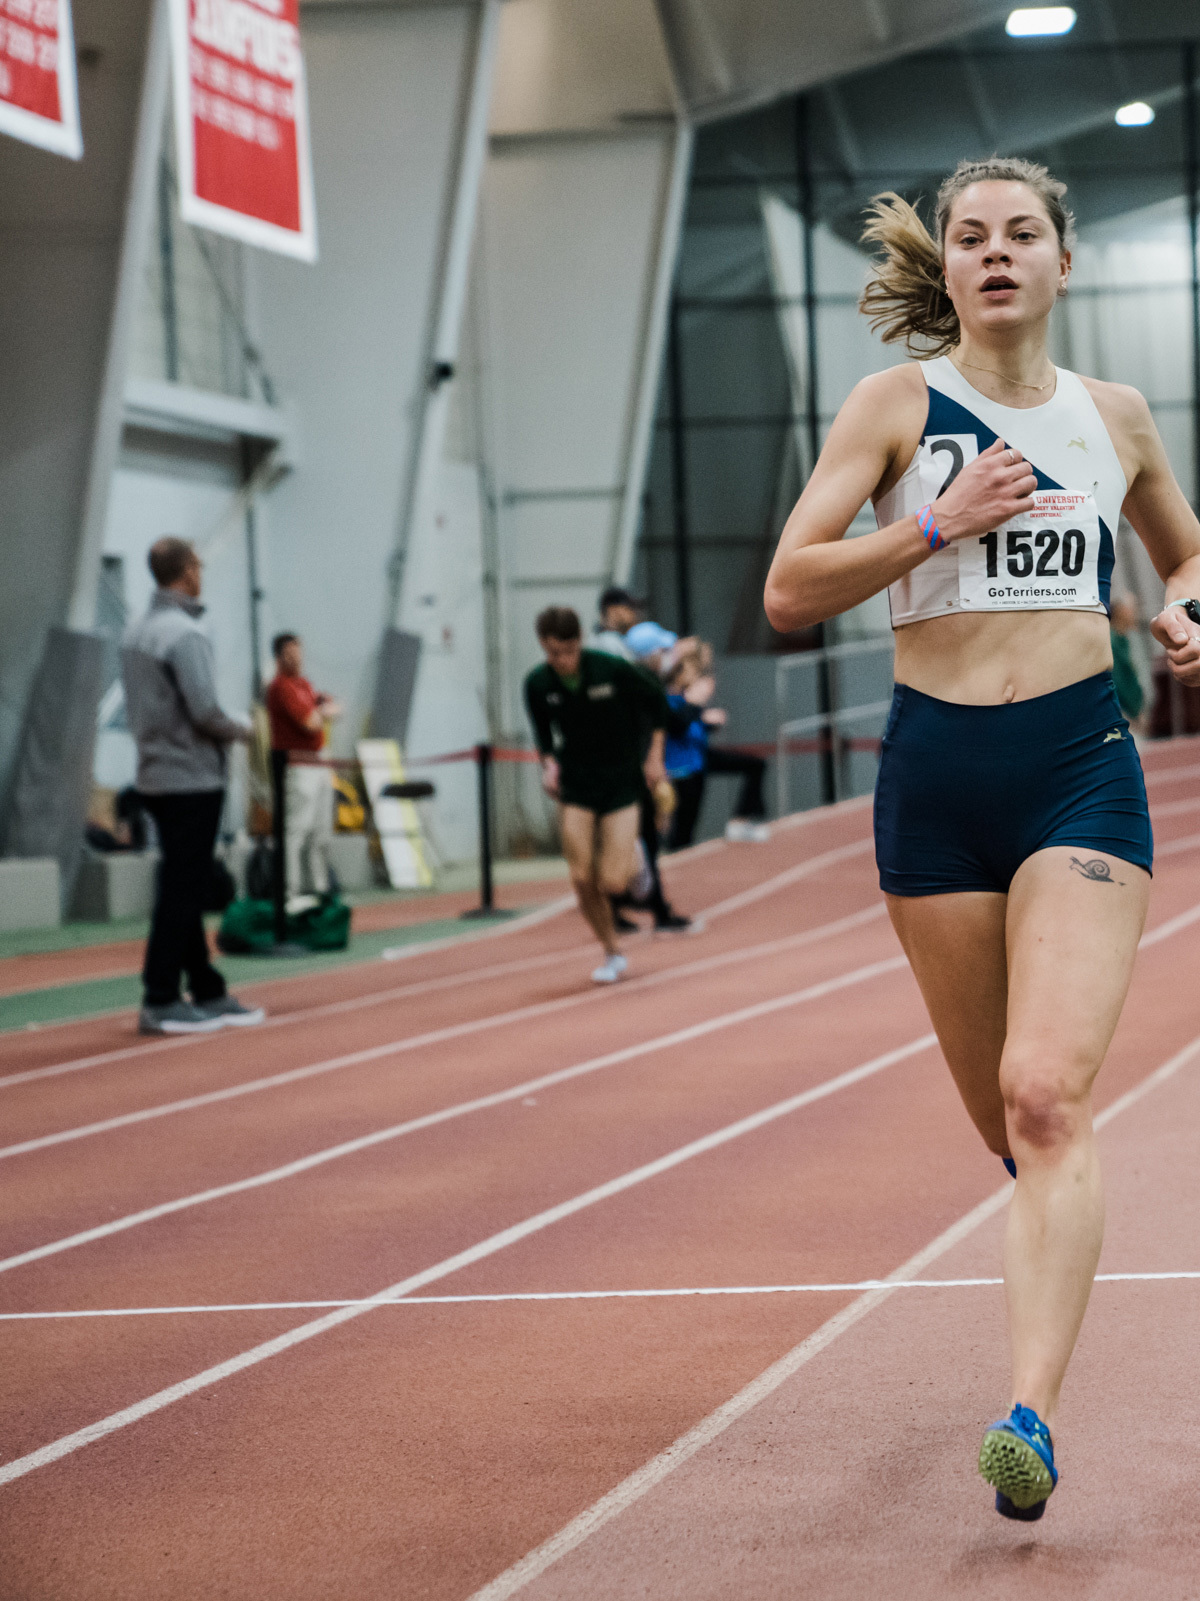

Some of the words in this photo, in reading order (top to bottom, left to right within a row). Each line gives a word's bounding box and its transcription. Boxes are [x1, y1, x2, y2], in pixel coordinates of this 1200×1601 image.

[930, 439, 963, 500] 2
[1036, 496, 1085, 504] UNIVERSITY
[979, 528, 1086, 578] 1520
[988, 587, 1077, 597] GoTerriers.com
